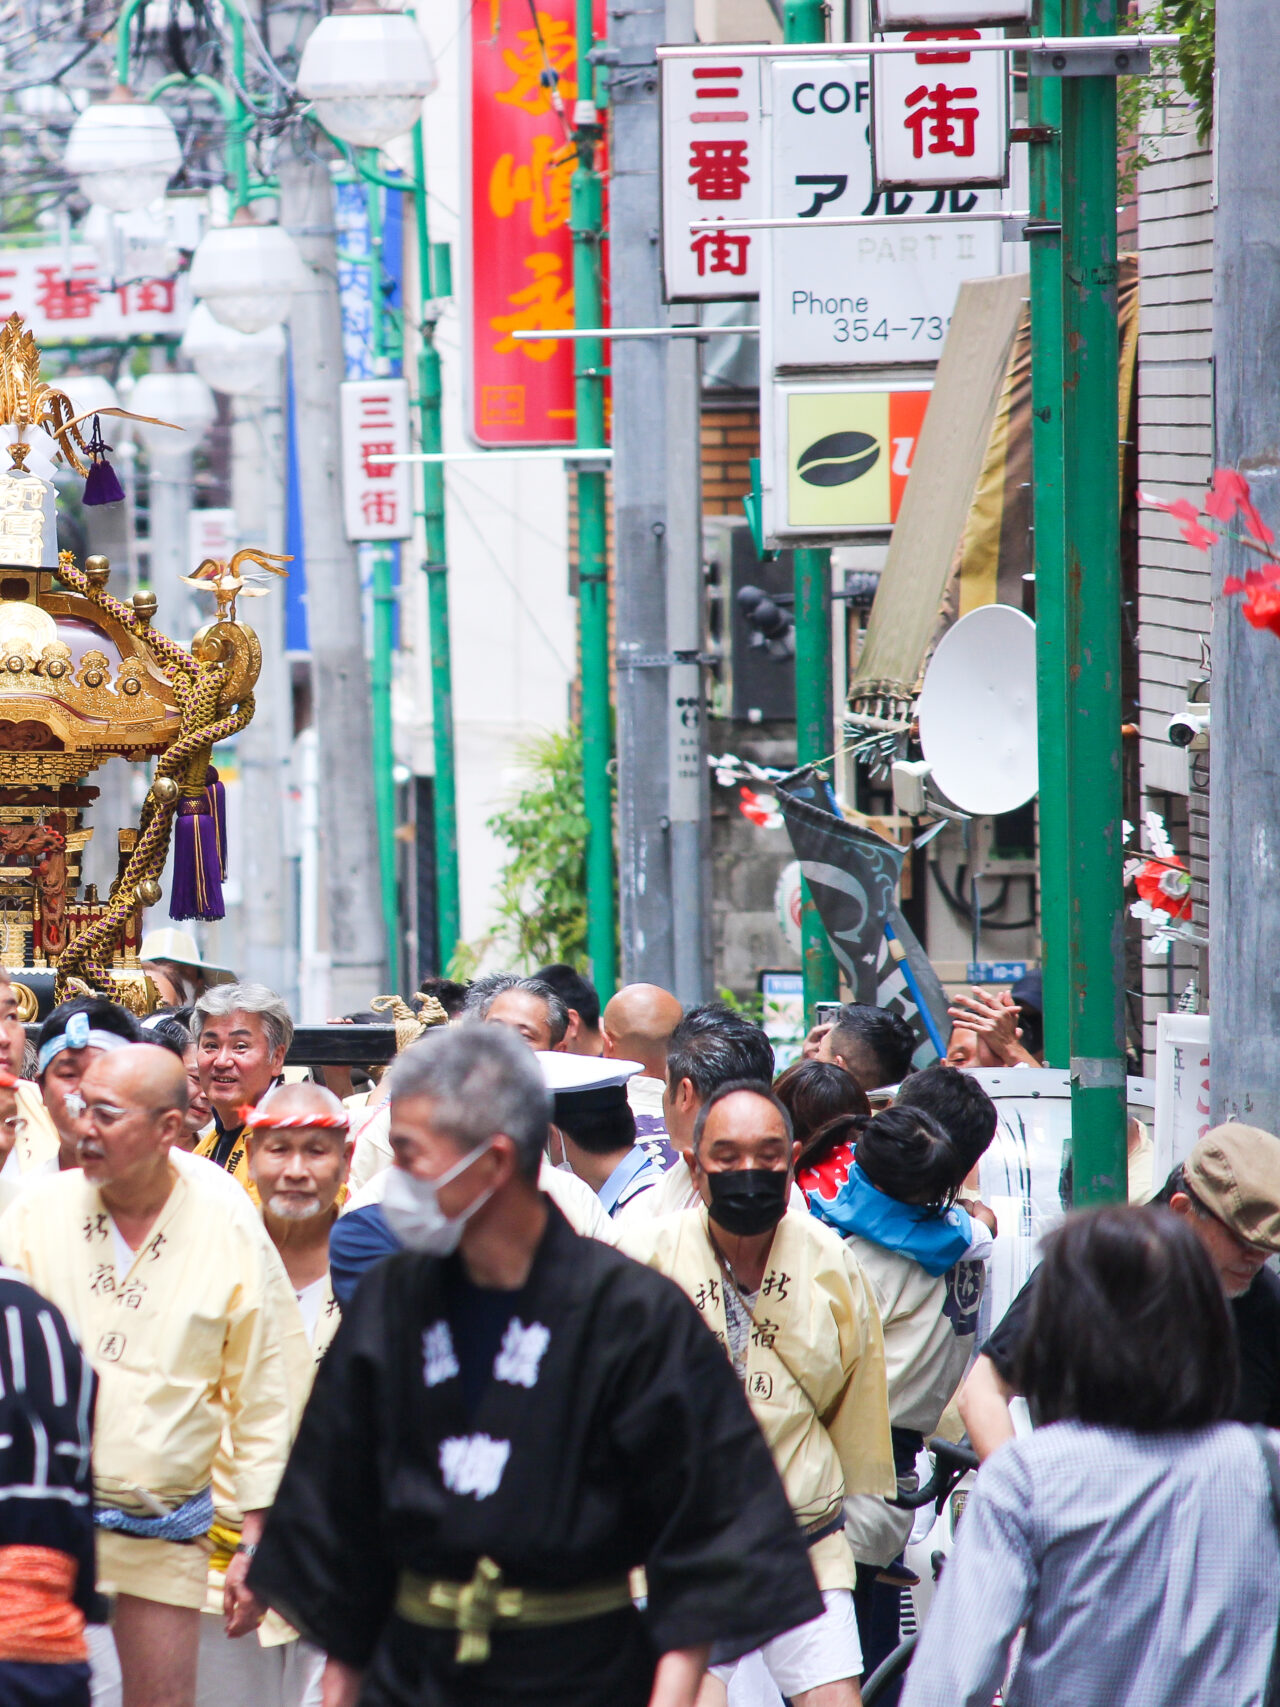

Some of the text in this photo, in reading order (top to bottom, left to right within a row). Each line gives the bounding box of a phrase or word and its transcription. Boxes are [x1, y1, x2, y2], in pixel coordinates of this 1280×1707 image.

[688, 67, 751, 276] 三番街
[792, 291, 868, 315] Phone
[360, 397, 397, 526] 三番街
